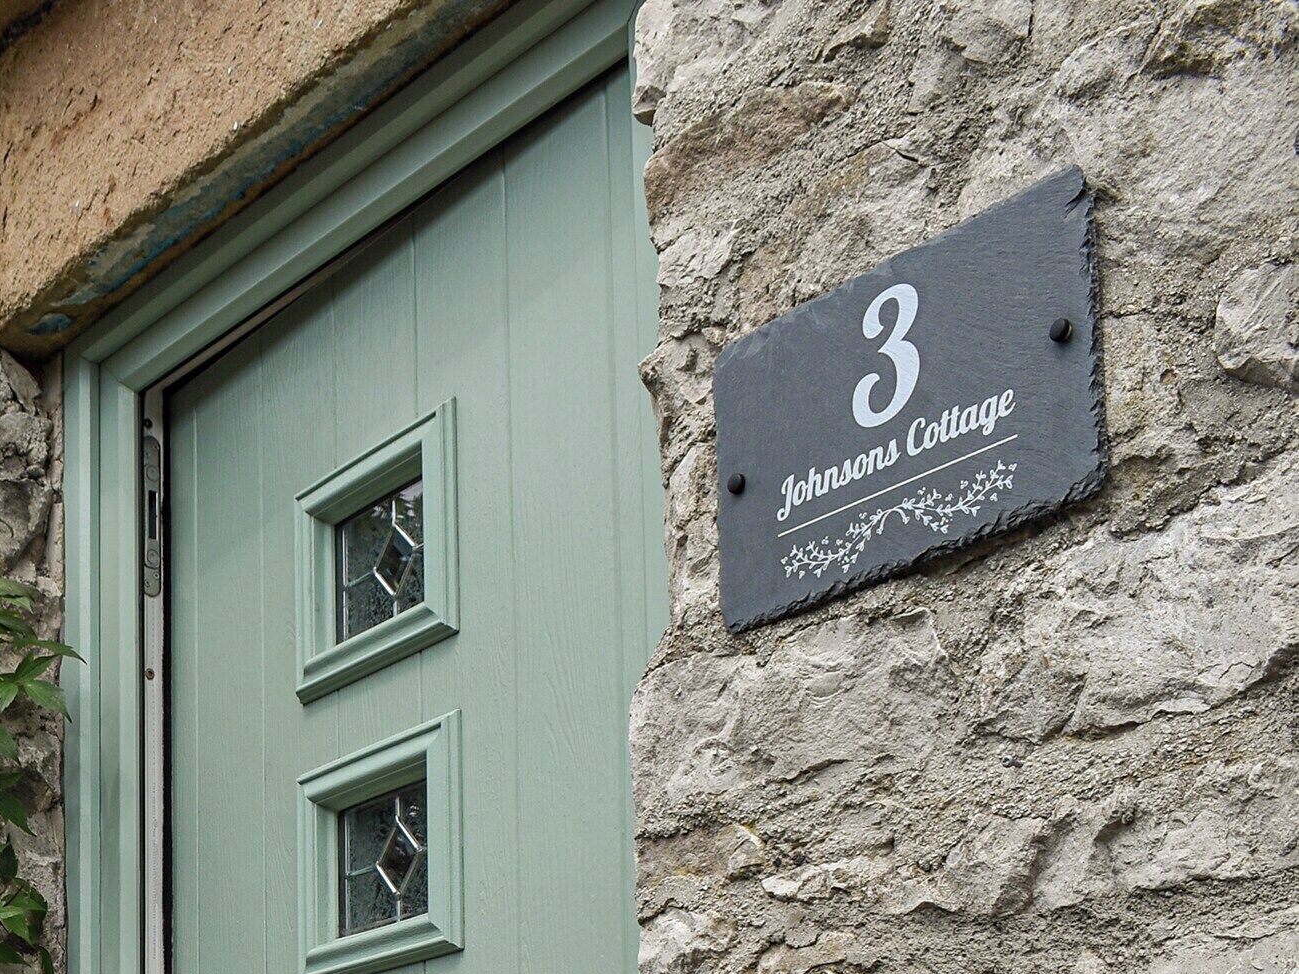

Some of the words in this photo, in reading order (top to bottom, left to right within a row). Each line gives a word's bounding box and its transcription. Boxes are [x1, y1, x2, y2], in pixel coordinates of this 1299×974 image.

[852, 283, 920, 428] 3
[776, 438, 900, 522] Johnsons
[907, 389, 1016, 457] Cottage
